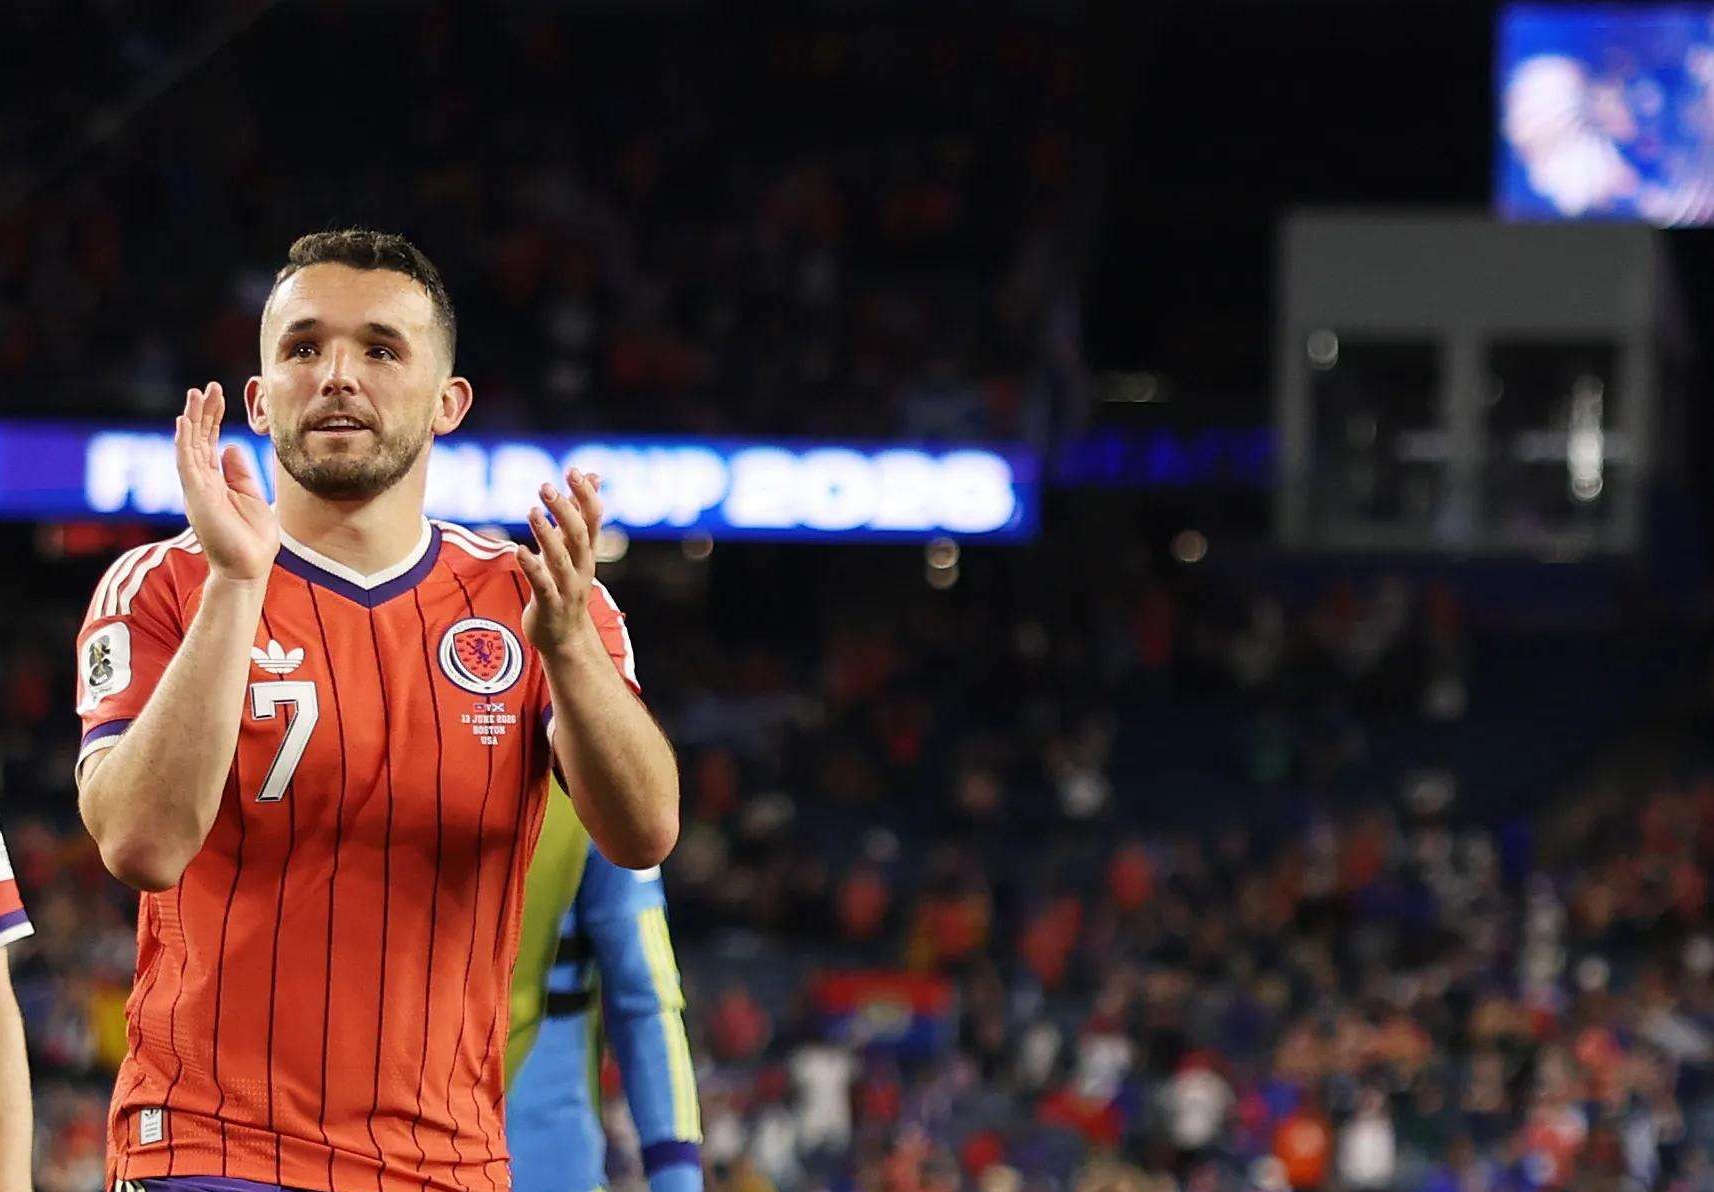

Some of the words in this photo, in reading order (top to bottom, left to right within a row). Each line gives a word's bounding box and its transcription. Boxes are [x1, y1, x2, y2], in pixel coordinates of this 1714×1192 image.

[723, 447, 1016, 533] 2026
[249, 680, 319, 802] 7
[473, 725, 506, 735] BOSTON
[480, 735, 498, 745] USA
